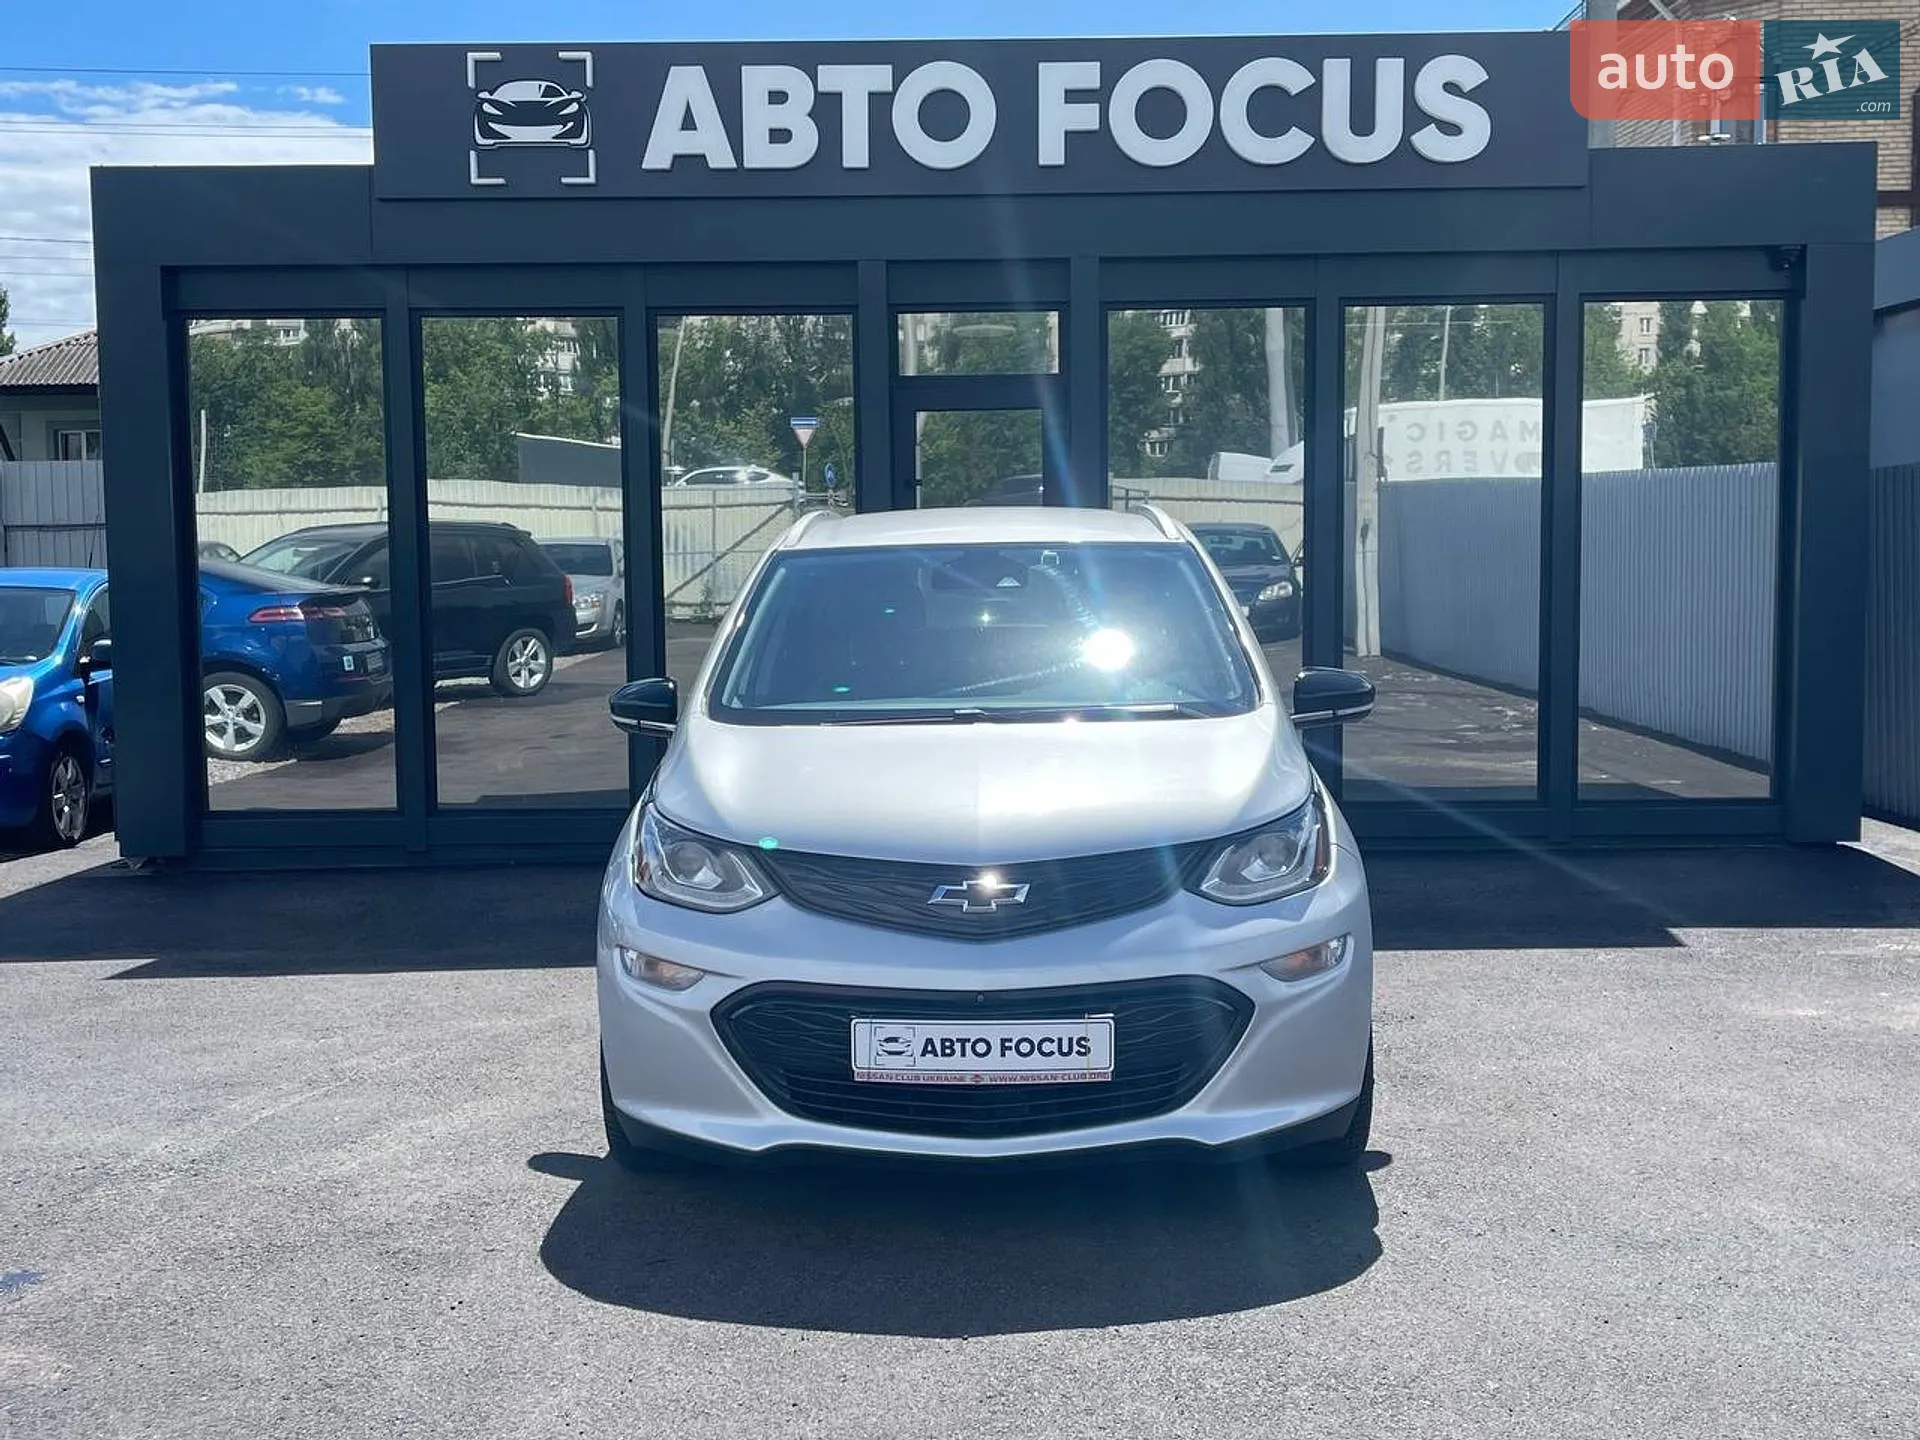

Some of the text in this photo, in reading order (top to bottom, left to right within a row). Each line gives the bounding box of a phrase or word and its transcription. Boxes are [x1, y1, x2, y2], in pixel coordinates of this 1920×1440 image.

[641, 54, 1492, 171] АВТО FOCUS
[920, 1036, 1092, 1058] АВТО FOCUS
